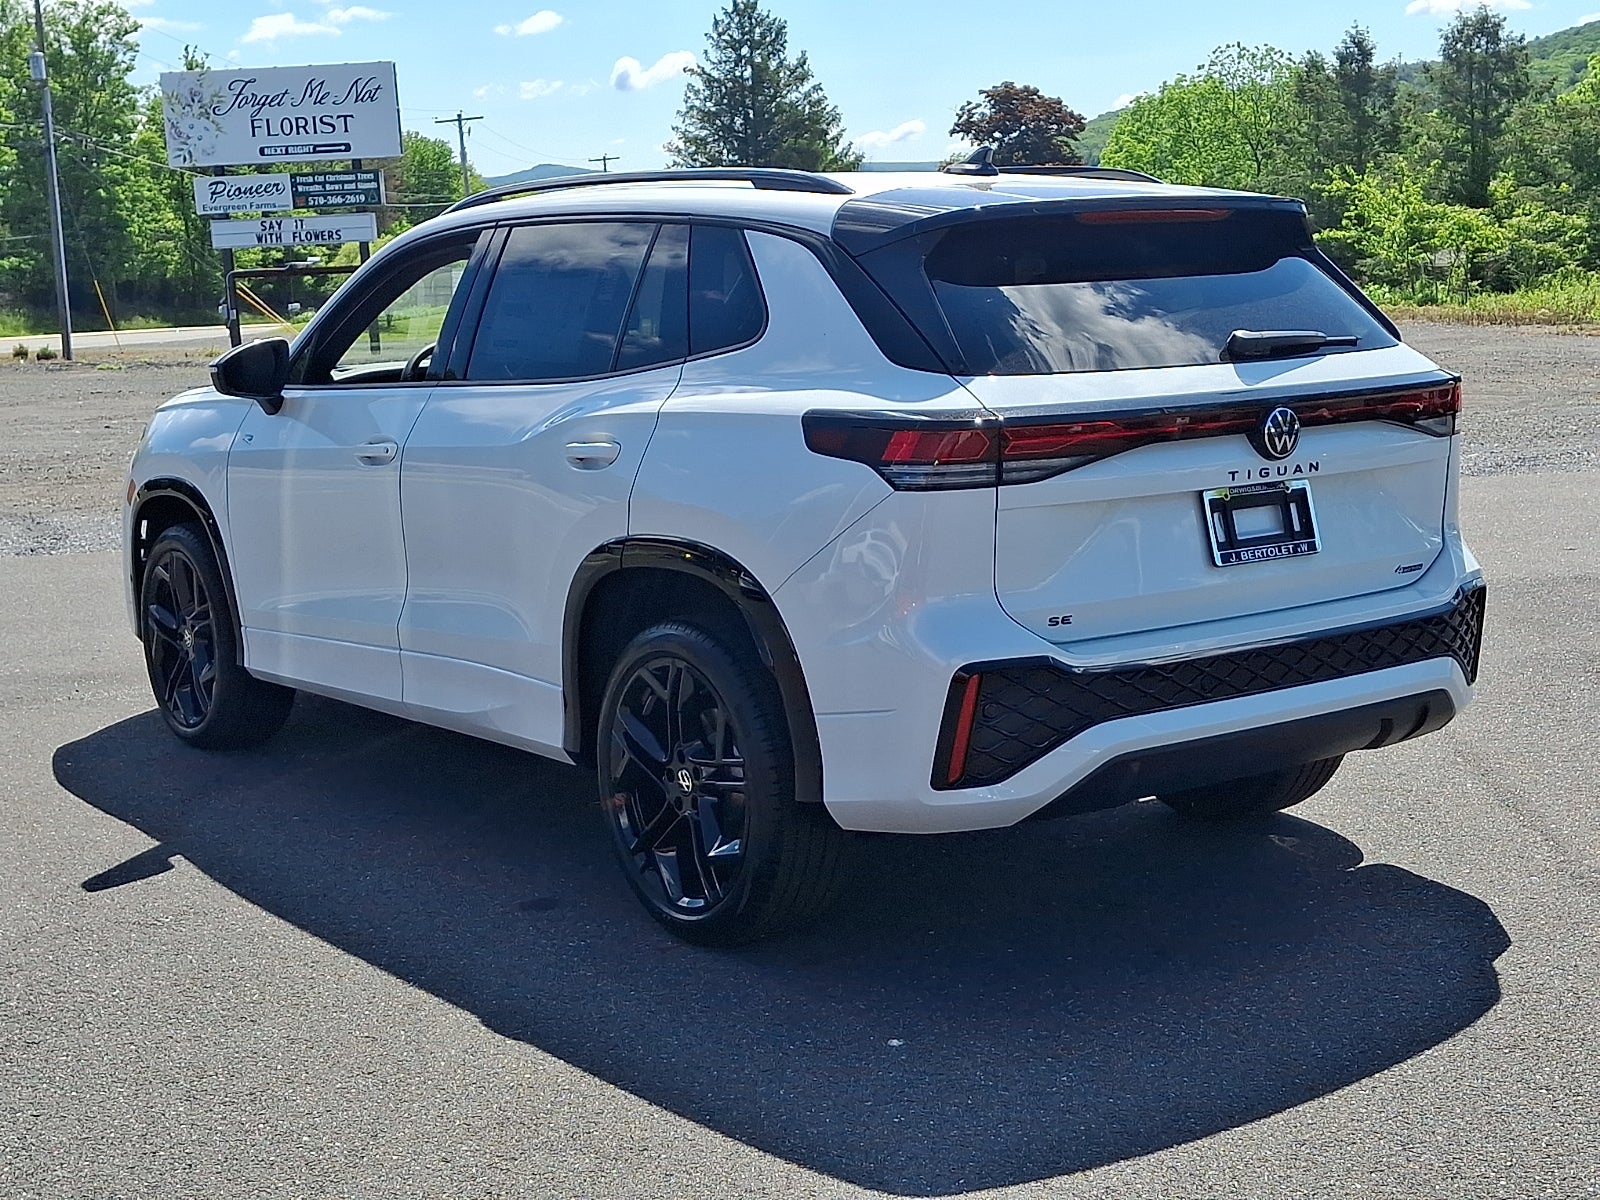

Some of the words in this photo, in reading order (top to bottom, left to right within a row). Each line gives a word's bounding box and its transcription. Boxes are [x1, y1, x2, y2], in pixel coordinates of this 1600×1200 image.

[250, 114, 355, 138] FLORIST
[264, 146, 286, 155] NEXT
[288, 145, 314, 154] RIGHT
[296, 175, 314, 183] Fresh
[326, 173, 356, 182] Christmas
[357, 172, 374, 180] Trees
[208, 180, 286, 203] Pioneer
[202, 202, 248, 212] Evergreen
[308, 194, 366, 206] 570-366-2619
[260, 219, 283, 232] SAY
[294, 218, 305, 230] IT
[255, 231, 283, 244] WITH
[292, 229, 342, 243] FLOWERS
[1228, 461, 1320, 482] TIGUAN
[1230, 553, 1239, 562] J.
[1240, 544, 1295, 561] BERTOLET
[1047, 614, 1073, 627] SE
